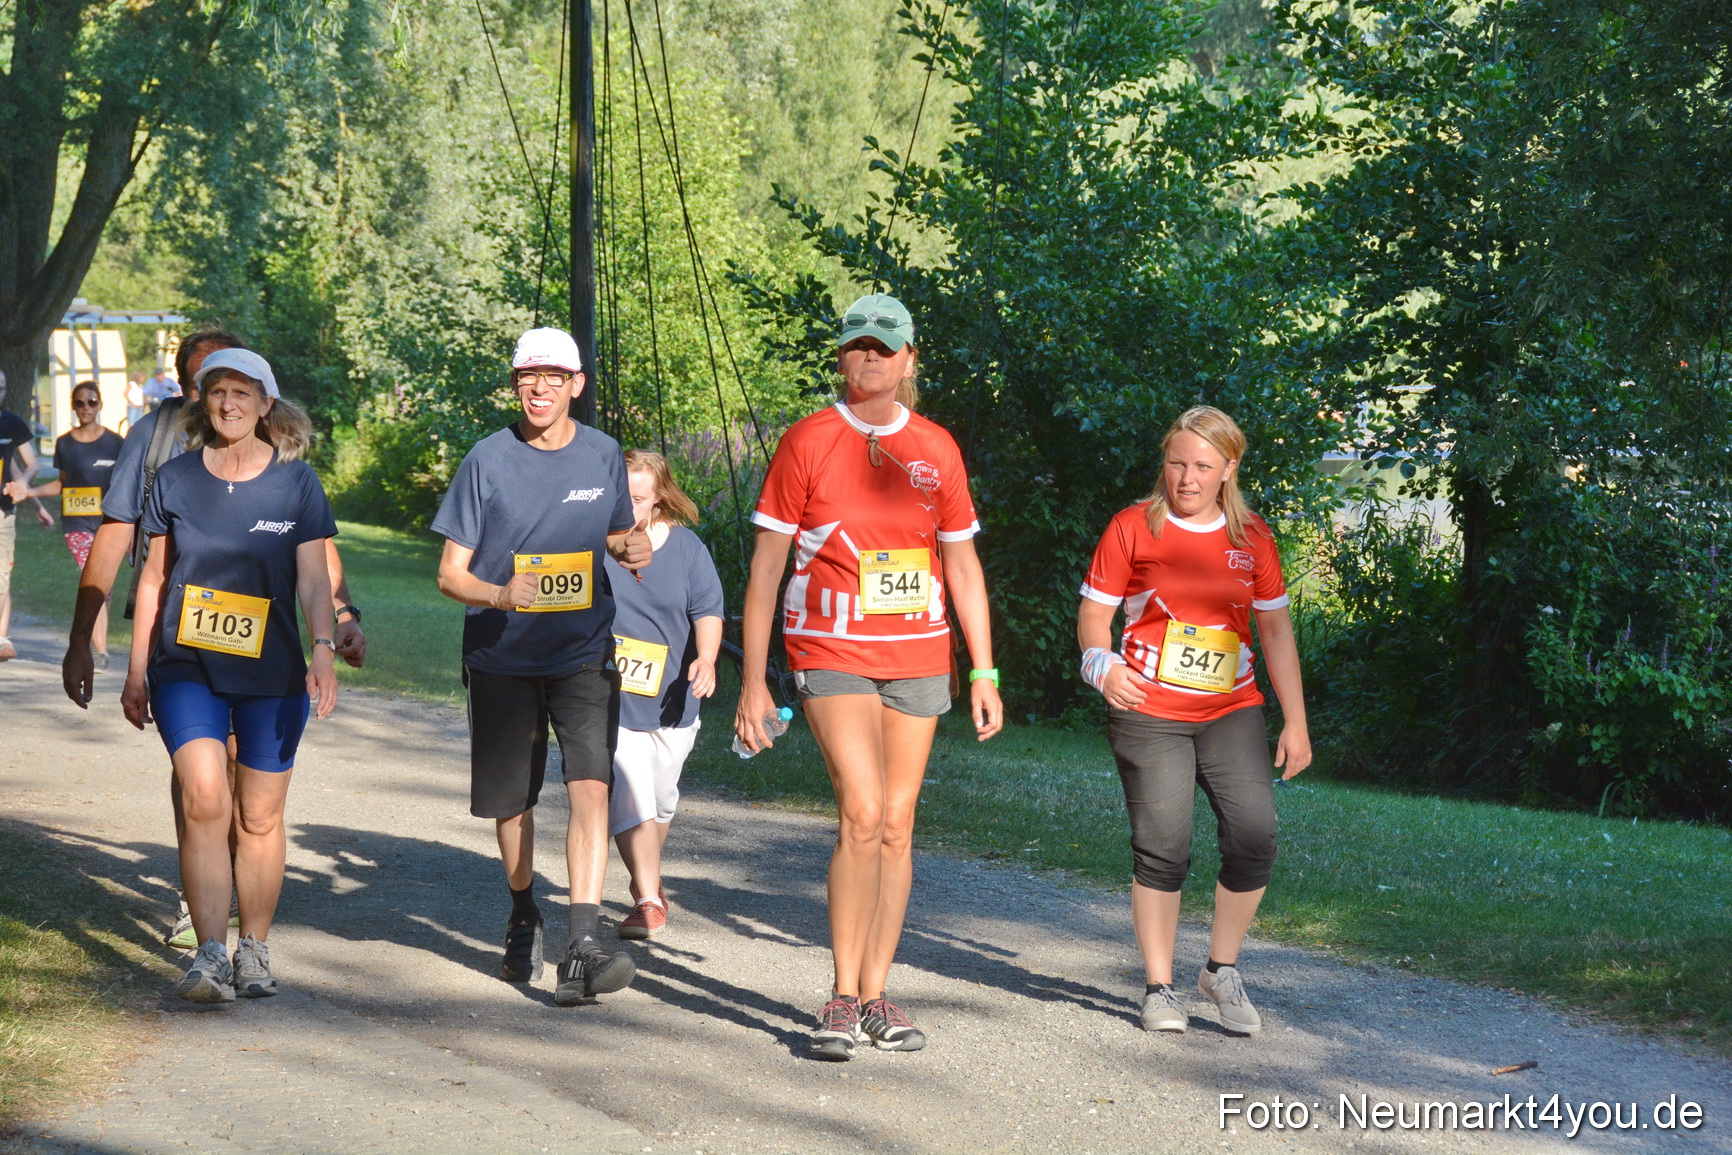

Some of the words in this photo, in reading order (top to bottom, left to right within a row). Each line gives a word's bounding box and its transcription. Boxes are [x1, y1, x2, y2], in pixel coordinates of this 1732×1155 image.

[907, 461, 932, 474] Town
[932, 469, 938, 477] &
[910, 472, 942, 490] Country
[69, 498, 95, 508] 1064
[1225, 550, 1248, 558] Town
[1228, 557, 1255, 572] Country
[540, 573, 582, 595] 099
[880, 572, 920, 595] 544
[192, 609, 253, 638] 1103
[197, 631, 226, 642] Wittmann
[616, 656, 653, 680] 071
[1180, 646, 1226, 673] 547
[1200, 672, 1224, 681] Gabrielle
